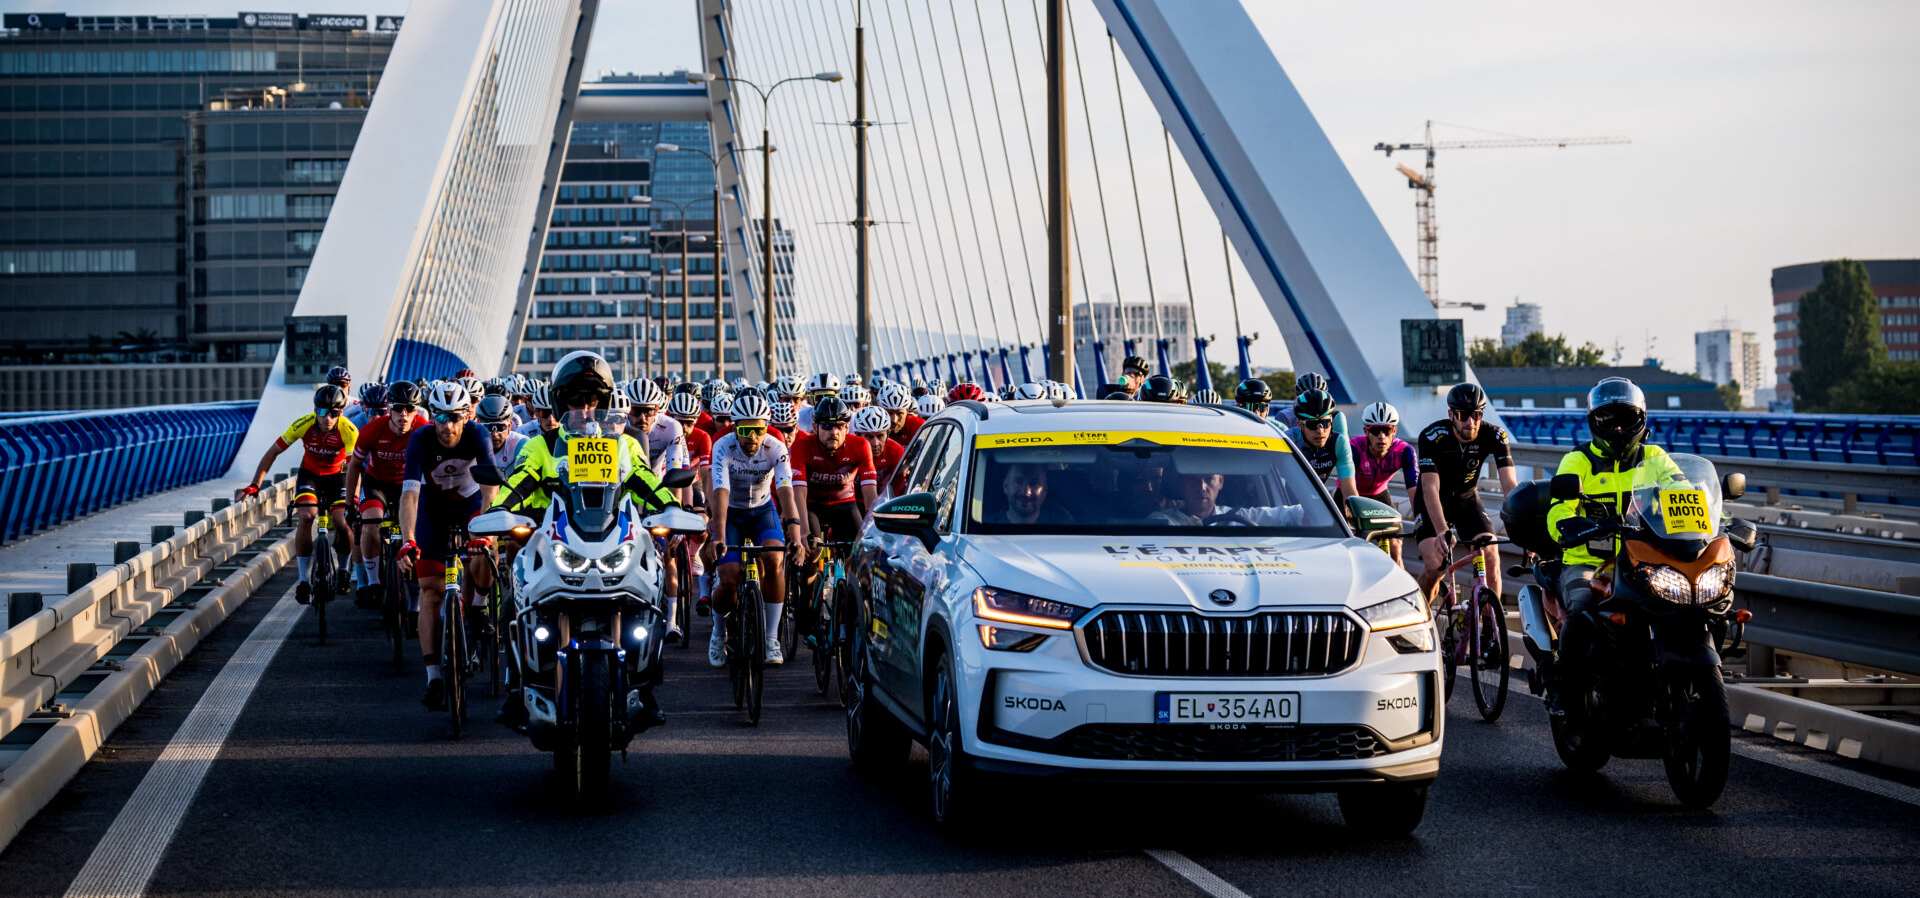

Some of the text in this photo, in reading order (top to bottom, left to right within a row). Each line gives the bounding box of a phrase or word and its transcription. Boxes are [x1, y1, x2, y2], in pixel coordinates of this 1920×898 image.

[577, 441, 609, 452] RACE
[994, 437, 1054, 445] SKODA
[574, 453, 613, 465] MOTO
[600, 468, 612, 478] 17
[1669, 493, 1700, 505] RACE
[1668, 505, 1705, 517] MOTO
[1696, 520, 1708, 530] 16
[1102, 543, 1283, 555] L'ÉTAPE
[1004, 696, 1067, 712] SKODA
[1177, 698, 1205, 719] EL
[1376, 696, 1418, 711] SKODA
[1158, 711, 1169, 719] SK
